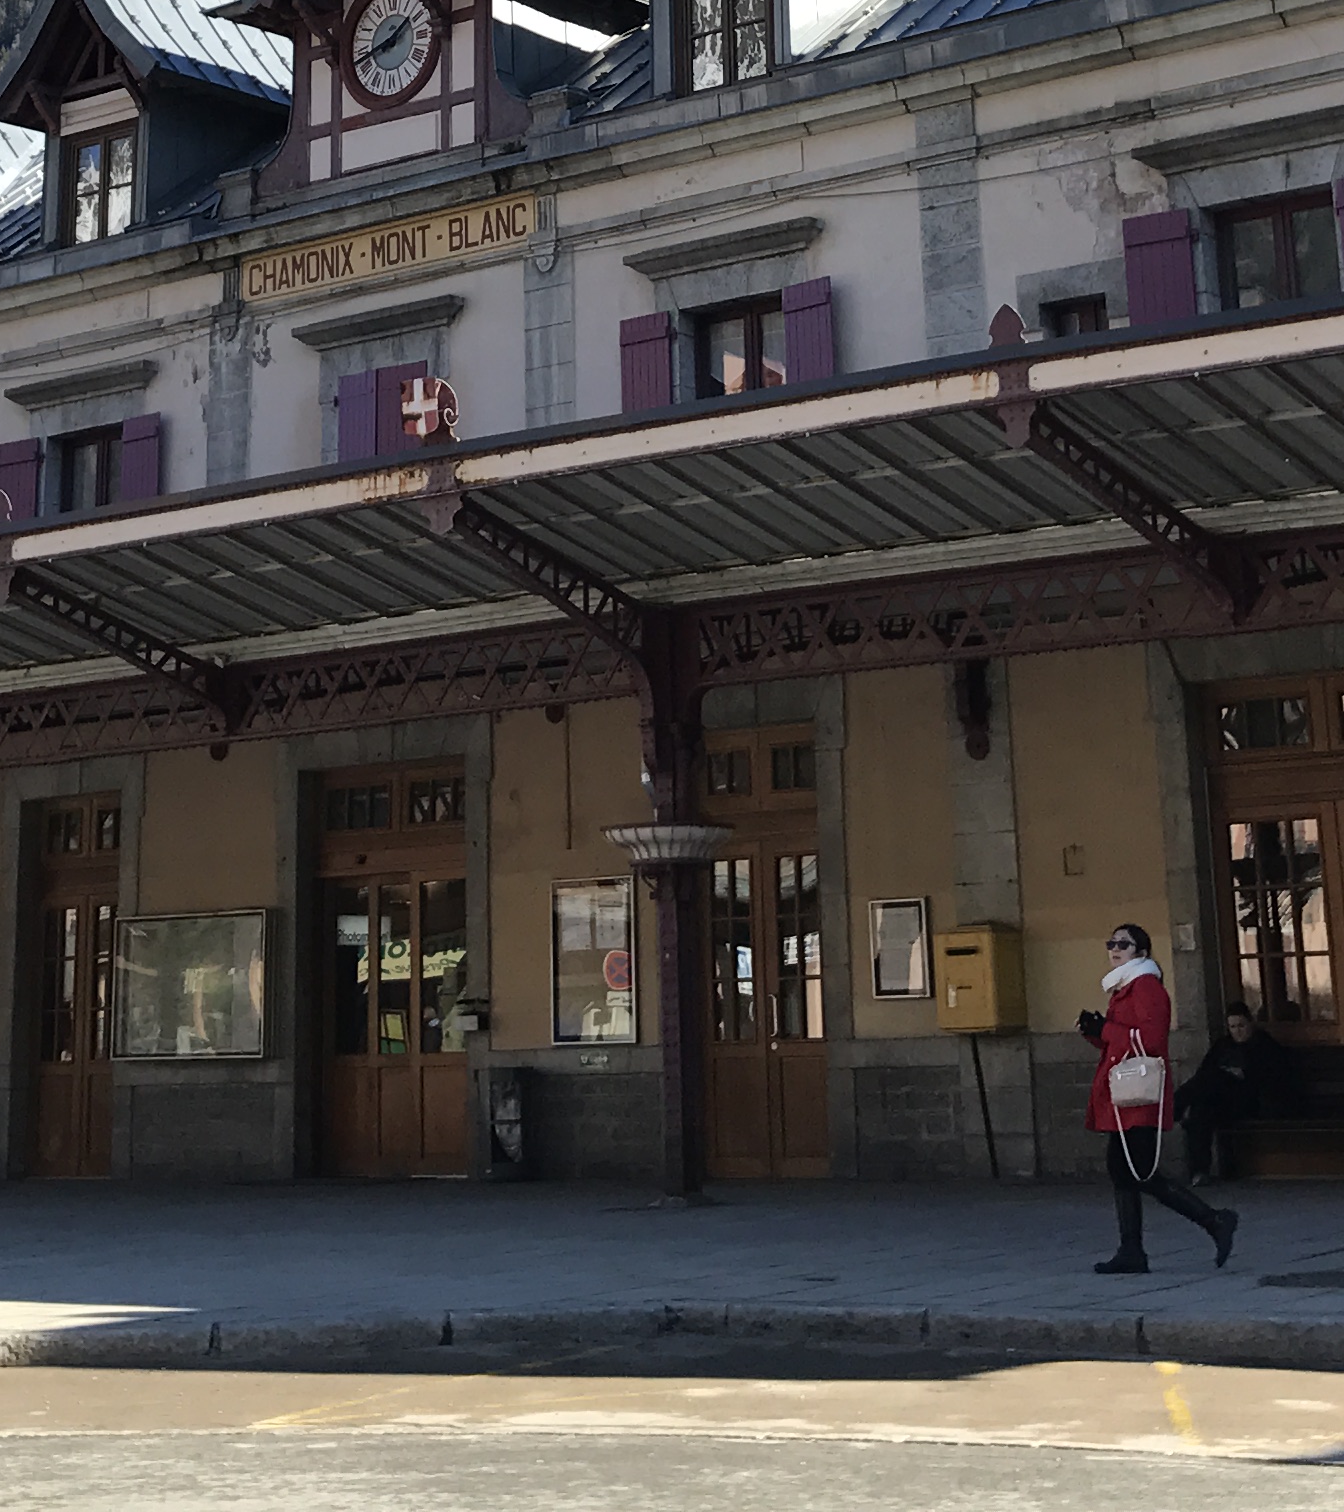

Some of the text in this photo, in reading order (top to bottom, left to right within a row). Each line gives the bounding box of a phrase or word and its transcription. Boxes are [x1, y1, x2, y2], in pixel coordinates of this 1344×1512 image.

[248, 242, 354, 297] CHAMONIX
[371, 224, 431, 270] MONT
[448, 202, 527, 252] BLANC
